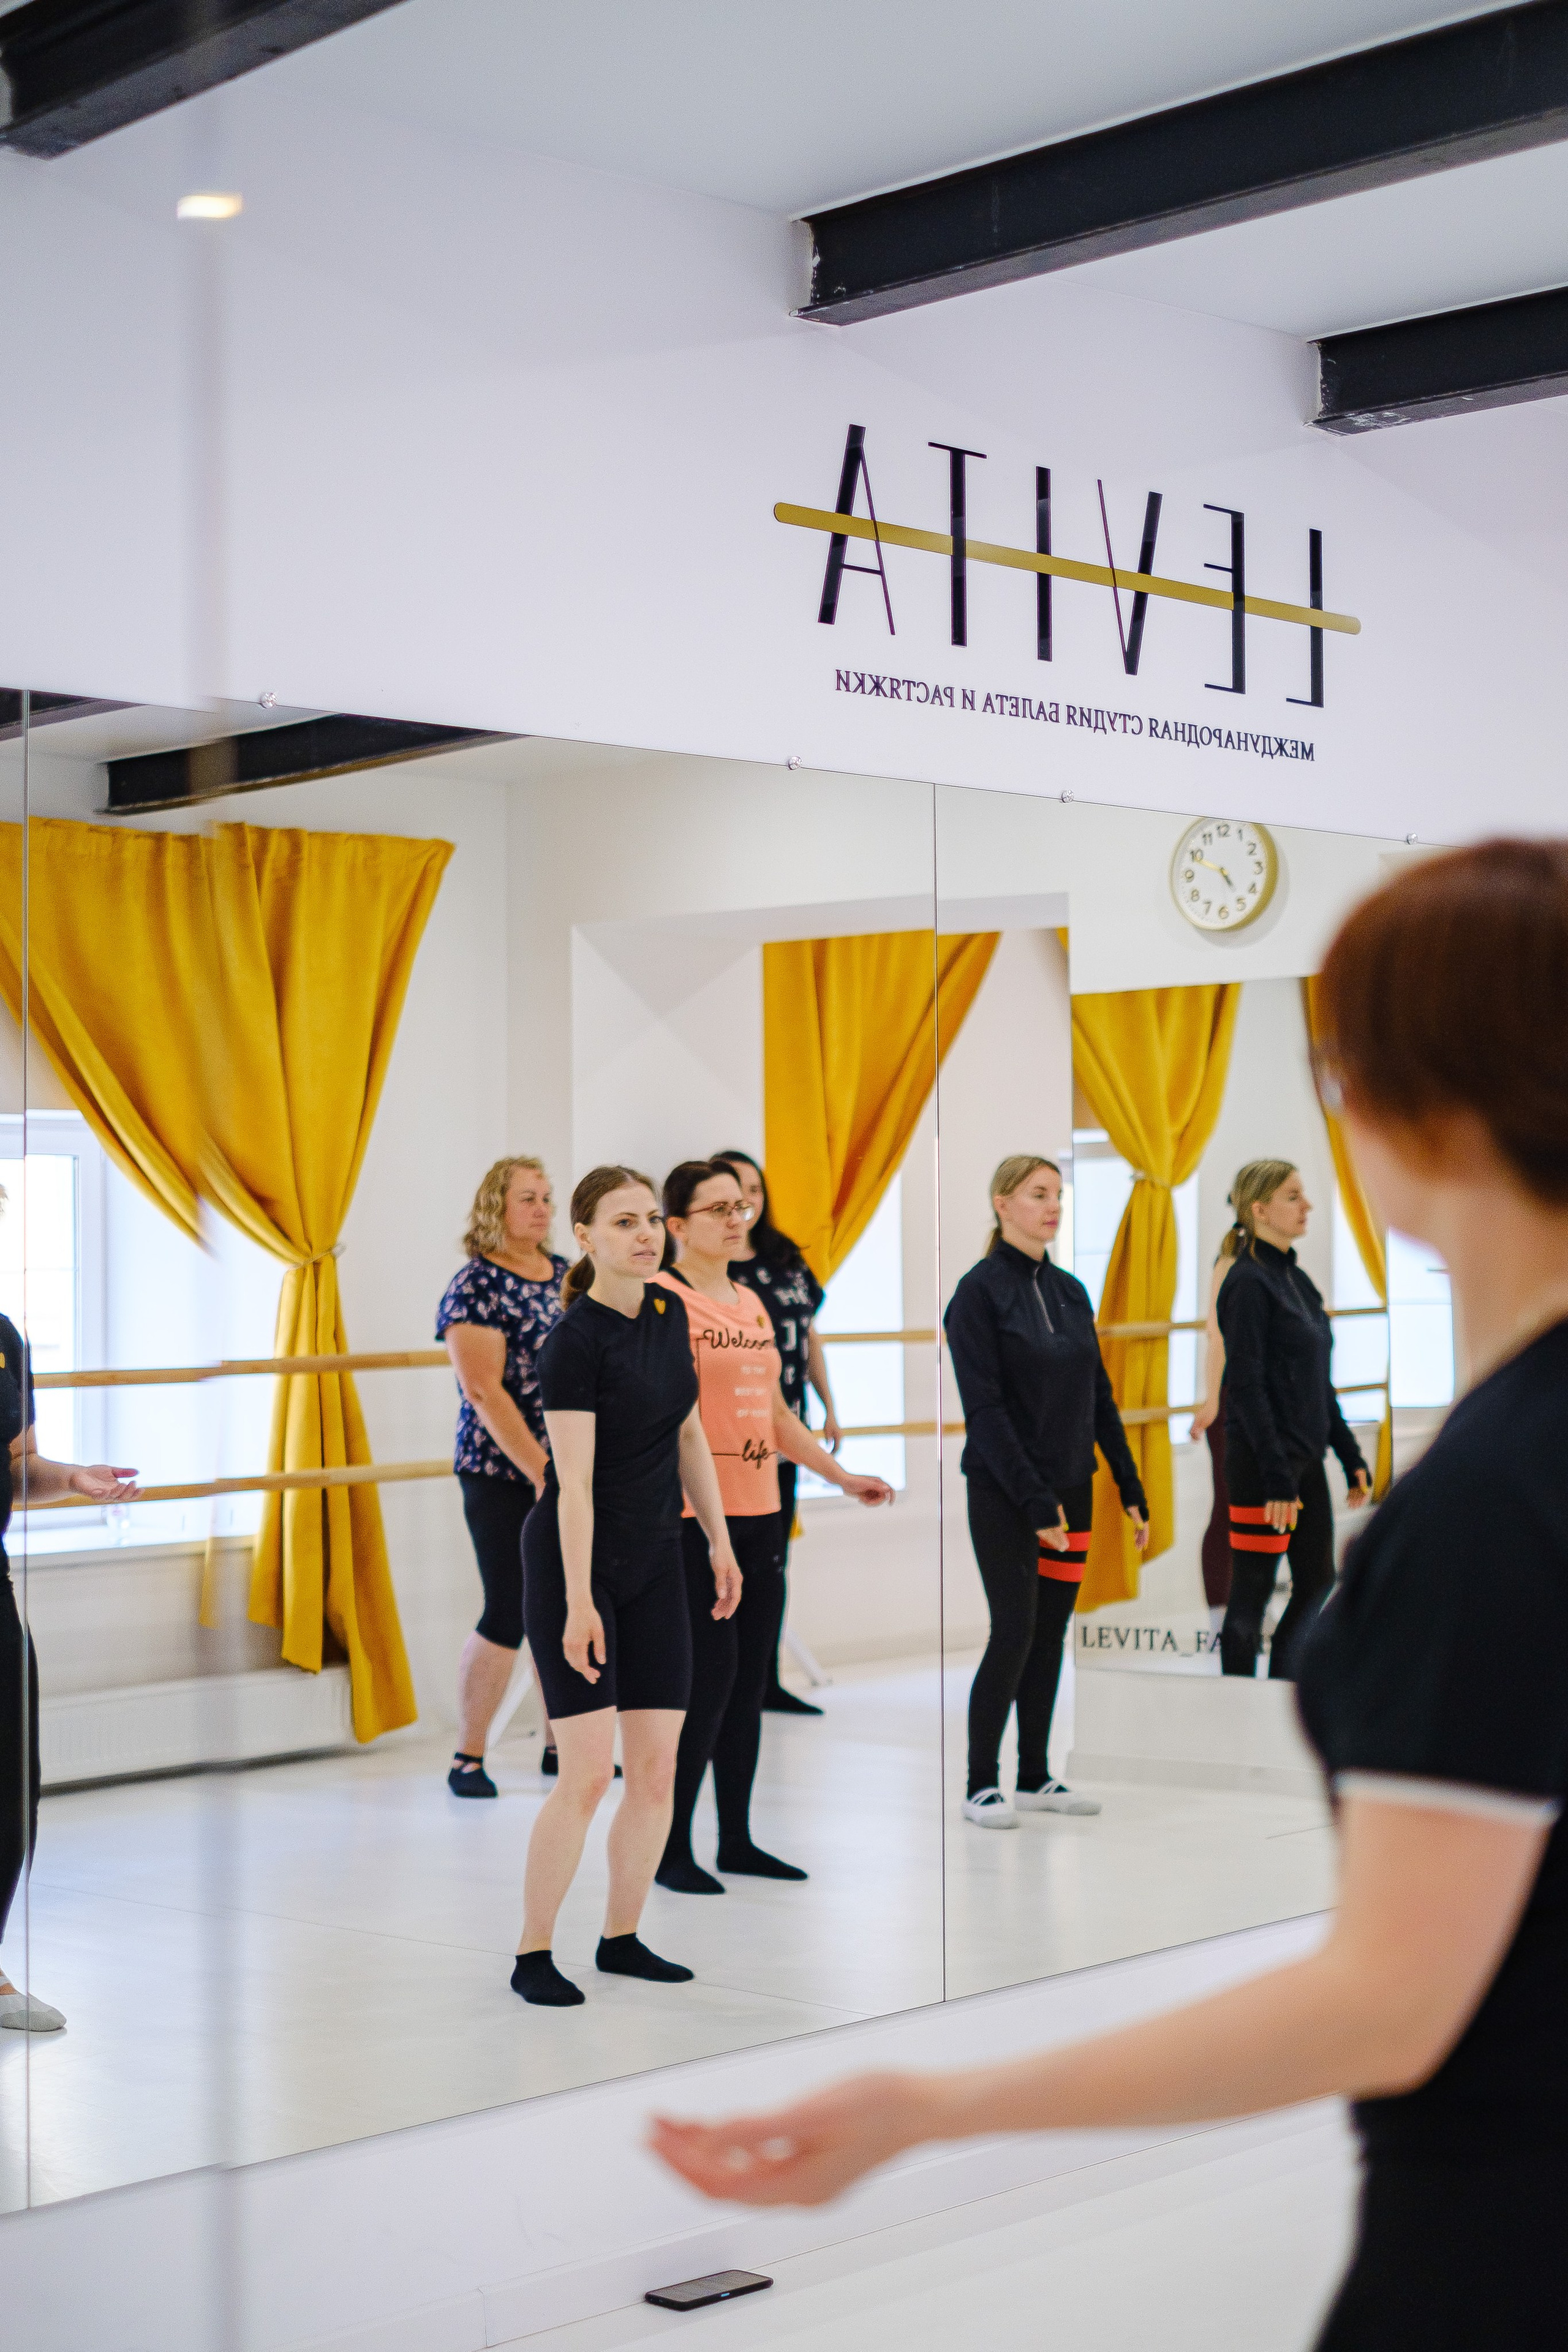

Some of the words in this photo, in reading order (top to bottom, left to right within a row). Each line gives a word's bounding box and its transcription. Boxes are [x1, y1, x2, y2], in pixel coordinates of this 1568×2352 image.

[1216, 824, 1231, 837] 12
[1238, 829, 1243, 842] 1
[1202, 832, 1213, 845] 11
[1189, 848, 1203, 862] 10
[1247, 842, 1257, 856] 2
[1254, 861, 1264, 875] 3
[1248, 882, 1257, 894] 4
[1190, 889, 1200, 902] 8
[1203, 900, 1212, 915] 7
[1236, 896, 1246, 911] 5
[1218, 905, 1229, 919] 6
[742, 1438, 769, 1469] life
[1082, 1626, 1222, 1658] LEVITA_FA
